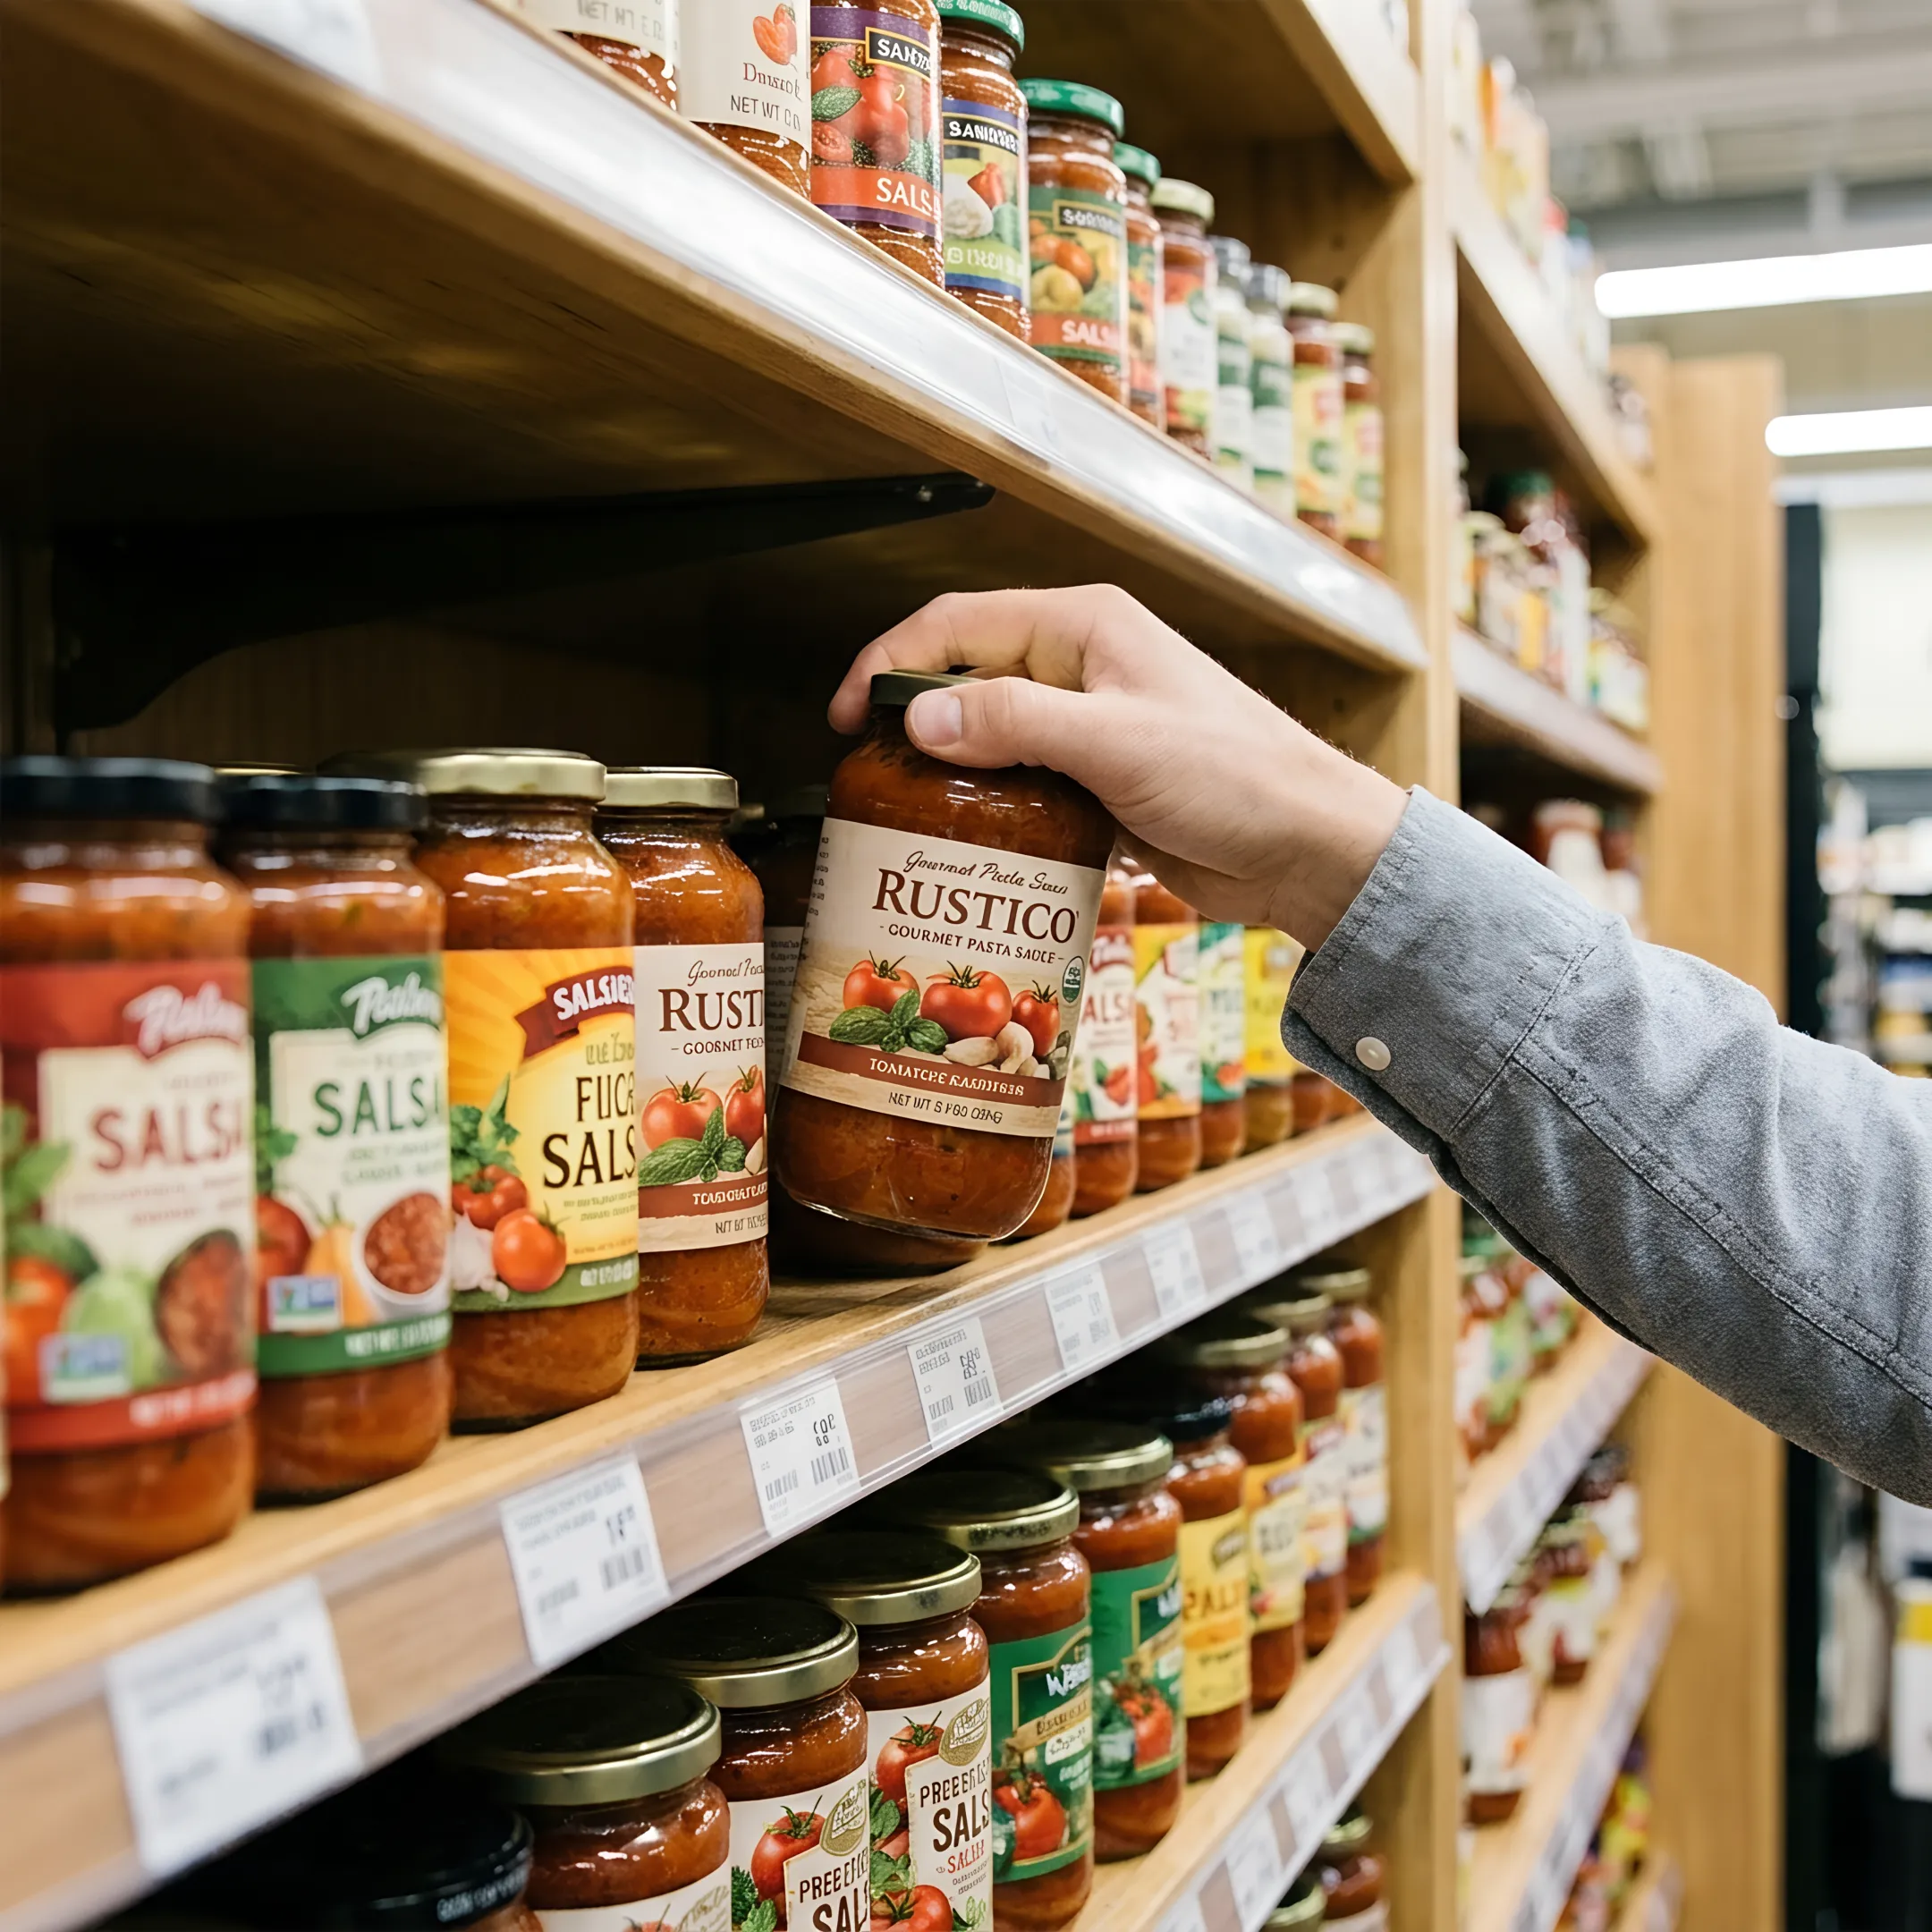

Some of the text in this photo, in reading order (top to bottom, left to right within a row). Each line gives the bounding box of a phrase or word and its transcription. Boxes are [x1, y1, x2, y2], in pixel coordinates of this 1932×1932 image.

[730, 94, 758, 114] NET
[871, 868, 1077, 945] RUSTICO
[966, 937, 1012, 958] PASTA
